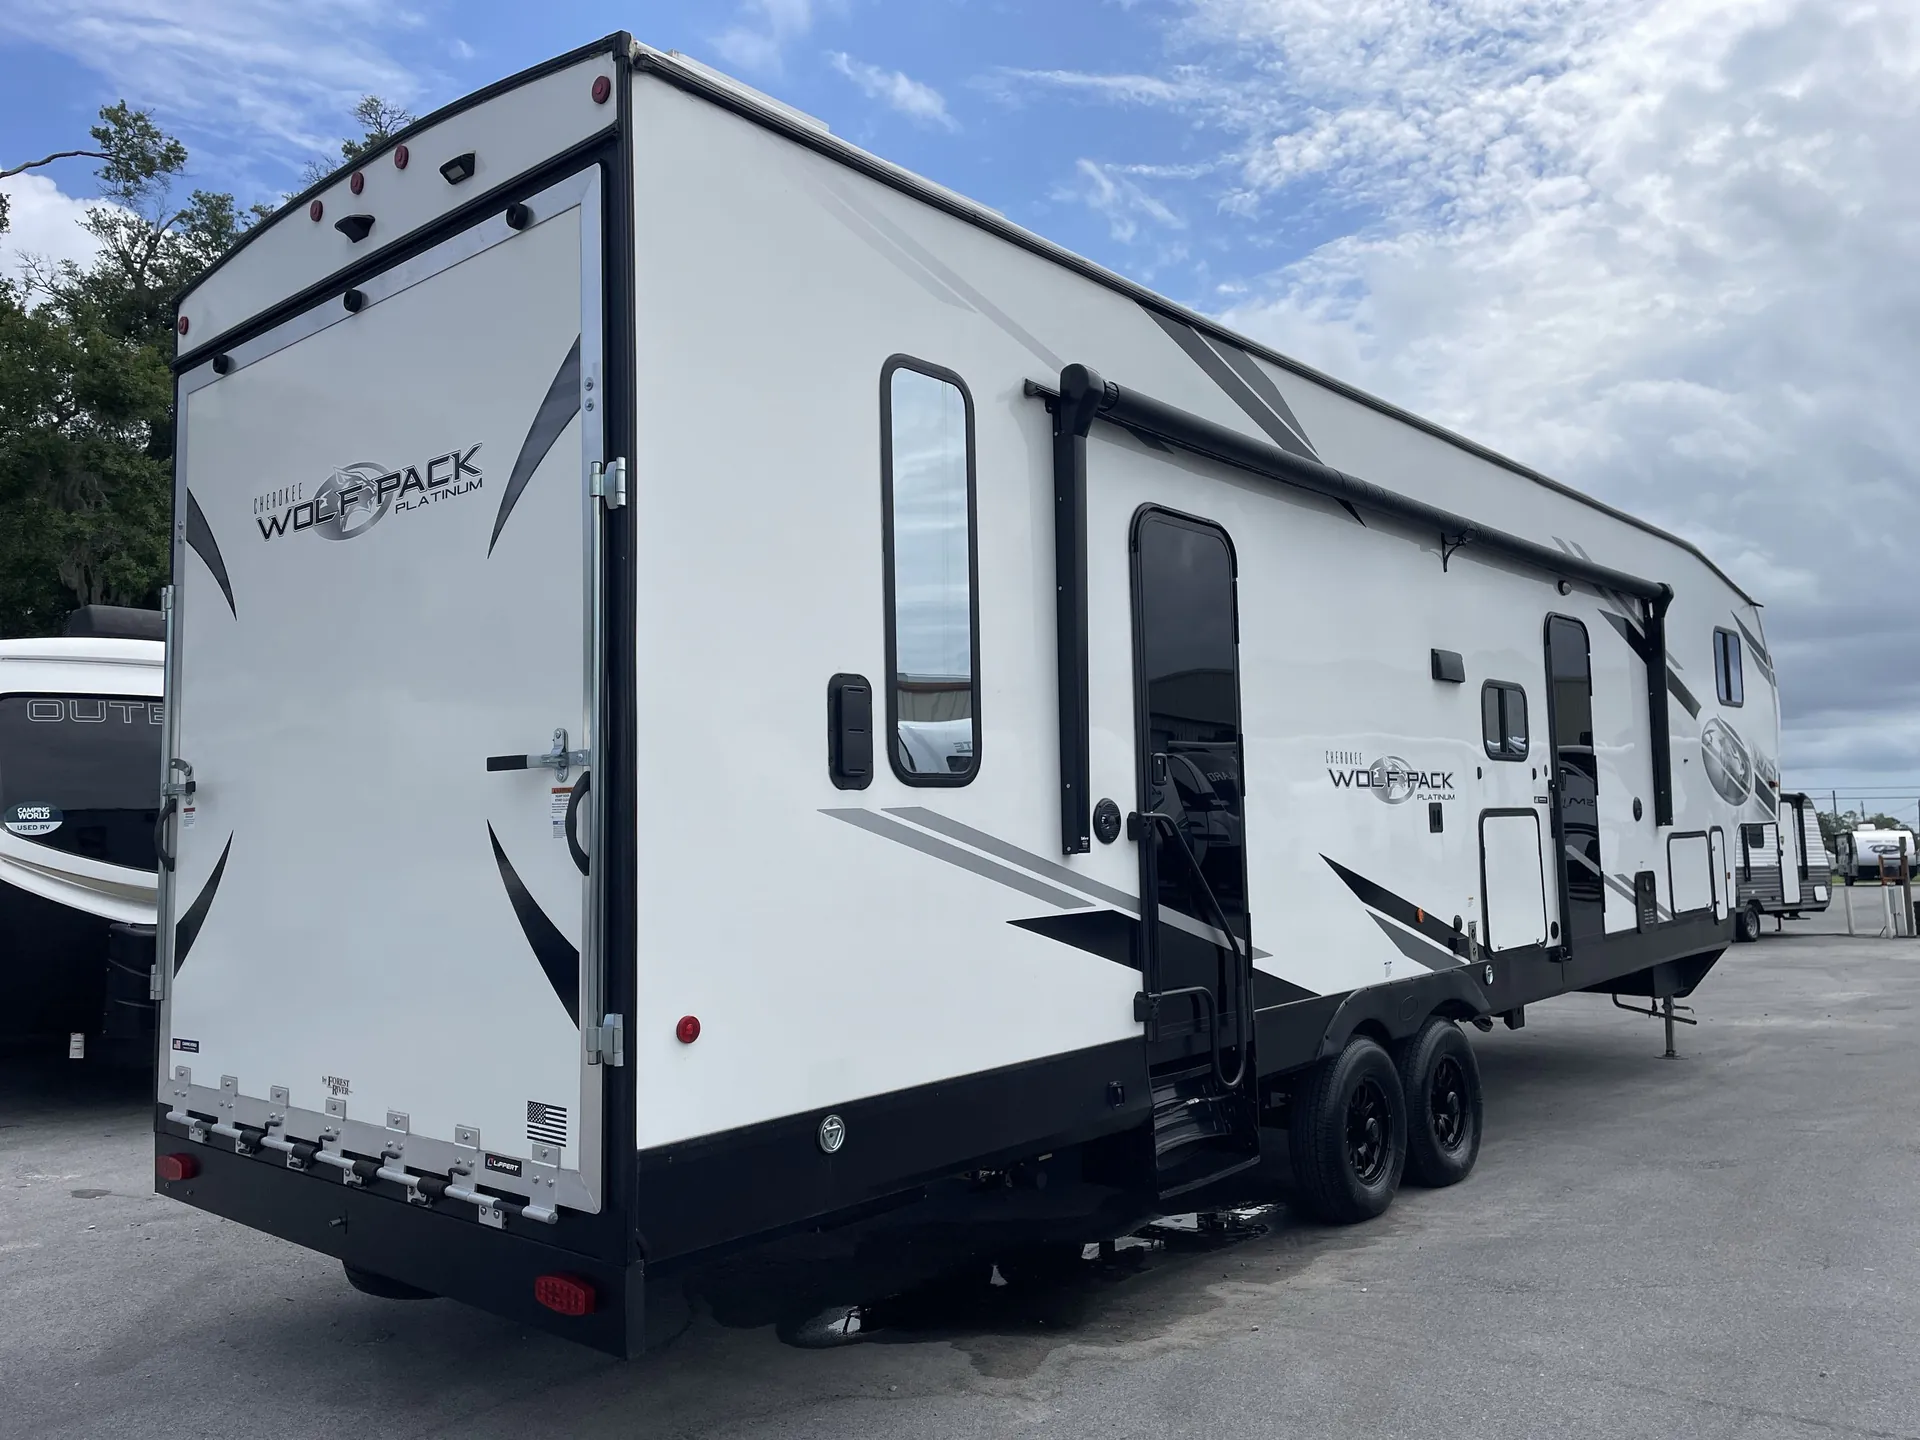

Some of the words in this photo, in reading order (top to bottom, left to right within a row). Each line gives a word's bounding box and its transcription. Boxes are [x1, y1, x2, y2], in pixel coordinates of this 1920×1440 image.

[253, 482, 303, 515] CHEROKEE
[256, 484, 363, 542] WOLF
[370, 441, 483, 507] PACK
[395, 477, 483, 514] PLATINUM
[1325, 750, 1362, 765] CHEROKEE
[1327, 767, 1399, 789] WOLF
[1406, 771, 1454, 789] PACK
[1417, 793, 1455, 801] PLATINUM
[17, 812, 50, 820] WORLD
[328, 1075, 350, 1088] FOREST
[332, 1084, 349, 1096] RIVER
[493, 1160, 519, 1171] LIPPERT
